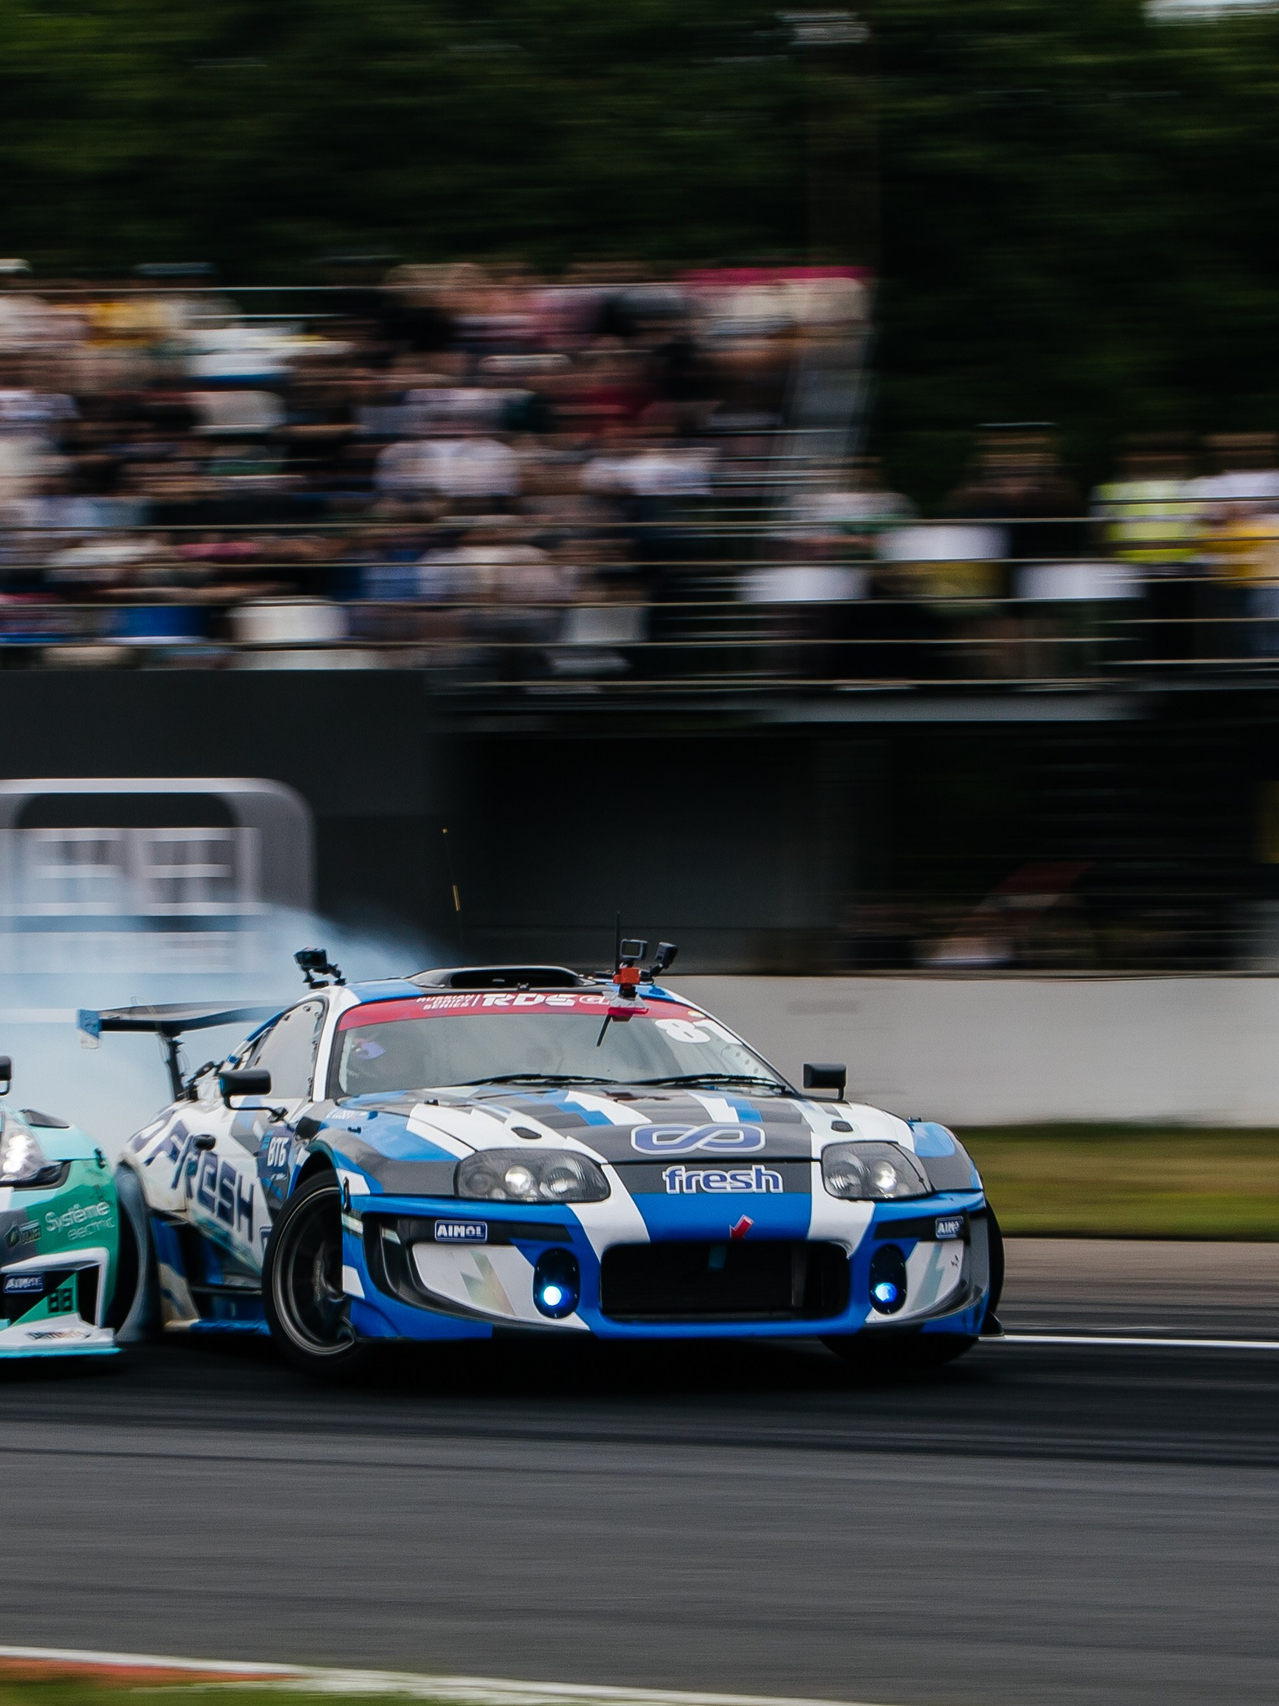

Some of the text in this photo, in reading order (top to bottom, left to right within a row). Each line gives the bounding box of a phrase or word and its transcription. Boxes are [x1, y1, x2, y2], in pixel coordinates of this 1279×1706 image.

[482, 993, 577, 1008] RDS
[661, 1165, 784, 1195] fresh
[437, 1224, 485, 1237] AIMOL
[46, 1286, 74, 1313] 88
